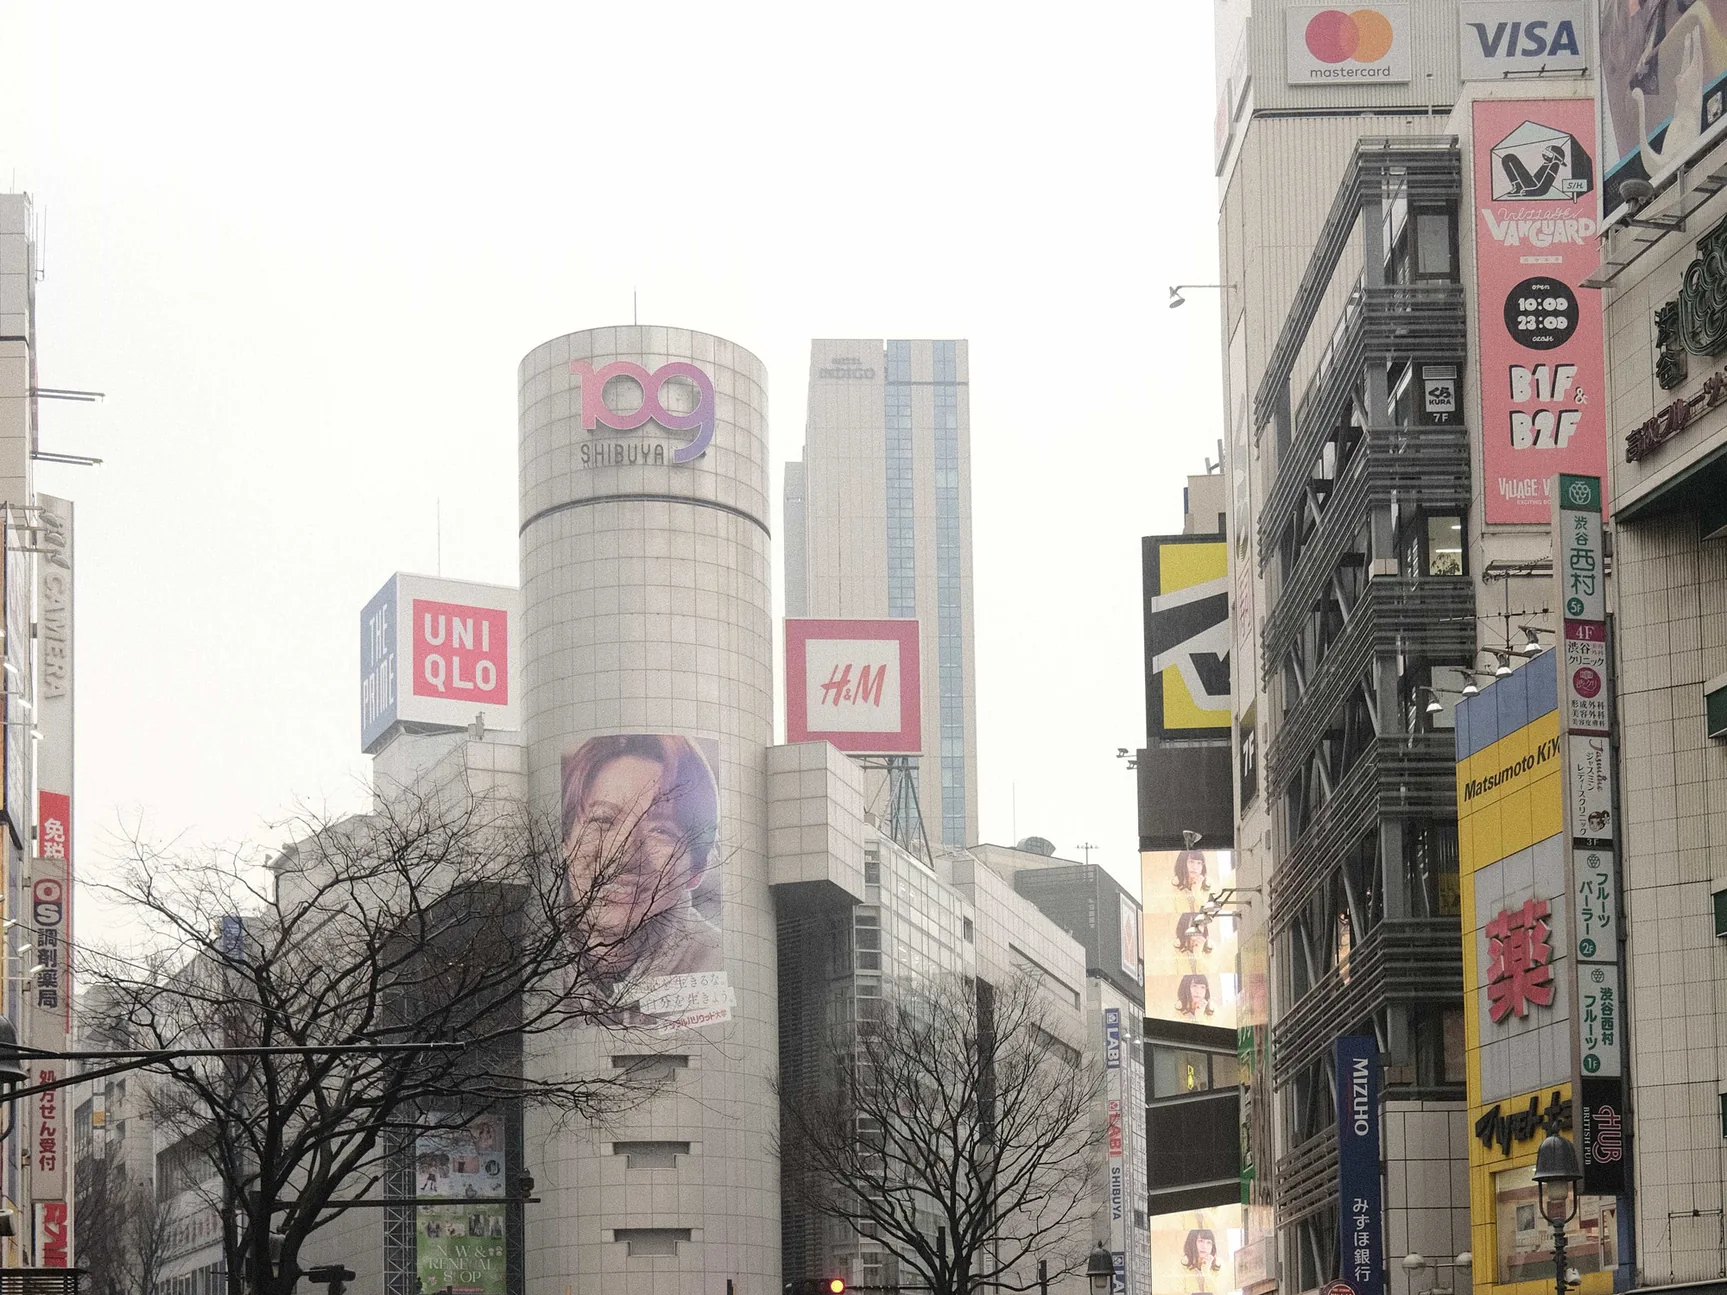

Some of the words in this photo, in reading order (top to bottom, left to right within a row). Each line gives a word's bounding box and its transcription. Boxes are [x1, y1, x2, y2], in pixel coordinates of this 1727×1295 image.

[1465, 20, 1580, 58] VISA
[1309, 65, 1391, 79] mastercard
[1481, 208, 1597, 247] VANGUARD
[1517, 297, 1569, 312] 10:00
[1517, 315, 1569, 330] 23:00
[1428, 398, 1452, 406] KURA
[1509, 364, 1577, 403] B1F
[1574, 386, 1588, 405] &
[569, 360, 716, 464] 109
[1433, 413, 1449, 422] 7F
[1509, 409, 1582, 449] B2F
[580, 444, 665, 465] SHIBUYA
[1569, 515, 1597, 596] 渋谷西村
[1570, 603, 1582, 613] 5F
[44, 571, 67, 700] CAMERA
[369, 604, 388, 668] THE
[424, 613, 490, 652] UNI
[1568, 641, 1590, 655] 渋谷
[1575, 626, 1595, 640] 4F
[424, 653, 497, 693] QLO
[1568, 656, 1605, 667] クリニック
[363, 653, 394, 730] PRIME
[819, 663, 888, 709] H&M
[1242, 729, 1255, 778] 7F
[1586, 751, 1594, 792] ジャスミン
[1463, 754, 1535, 803] Matsumoto
[1586, 838, 1599, 847] 3F
[34, 878, 63, 927] OS
[1579, 880, 1594, 936] パーラー
[1596, 872, 1611, 928] フルーツ
[37, 927, 58, 1008] 調剤薬局
[1483, 896, 1556, 1025] 薬
[1582, 942, 1595, 954] 2F
[1583, 994, 1598, 1051] フルーツ
[1600, 986, 1614, 1047] 渋谷西村
[1107, 1027, 1120, 1066] LABI
[1586, 1058, 1598, 1070] 1F
[1353, 1058, 1369, 1136] MIZUHO
[1583, 1106, 1591, 1144] BRITISH
[1592, 1104, 1623, 1164] HUB
[1584, 1145, 1592, 1165] PUB
[1111, 1166, 1121, 1220] SHIBUYA
[1352, 1198, 1371, 1283] みずほ銀行
